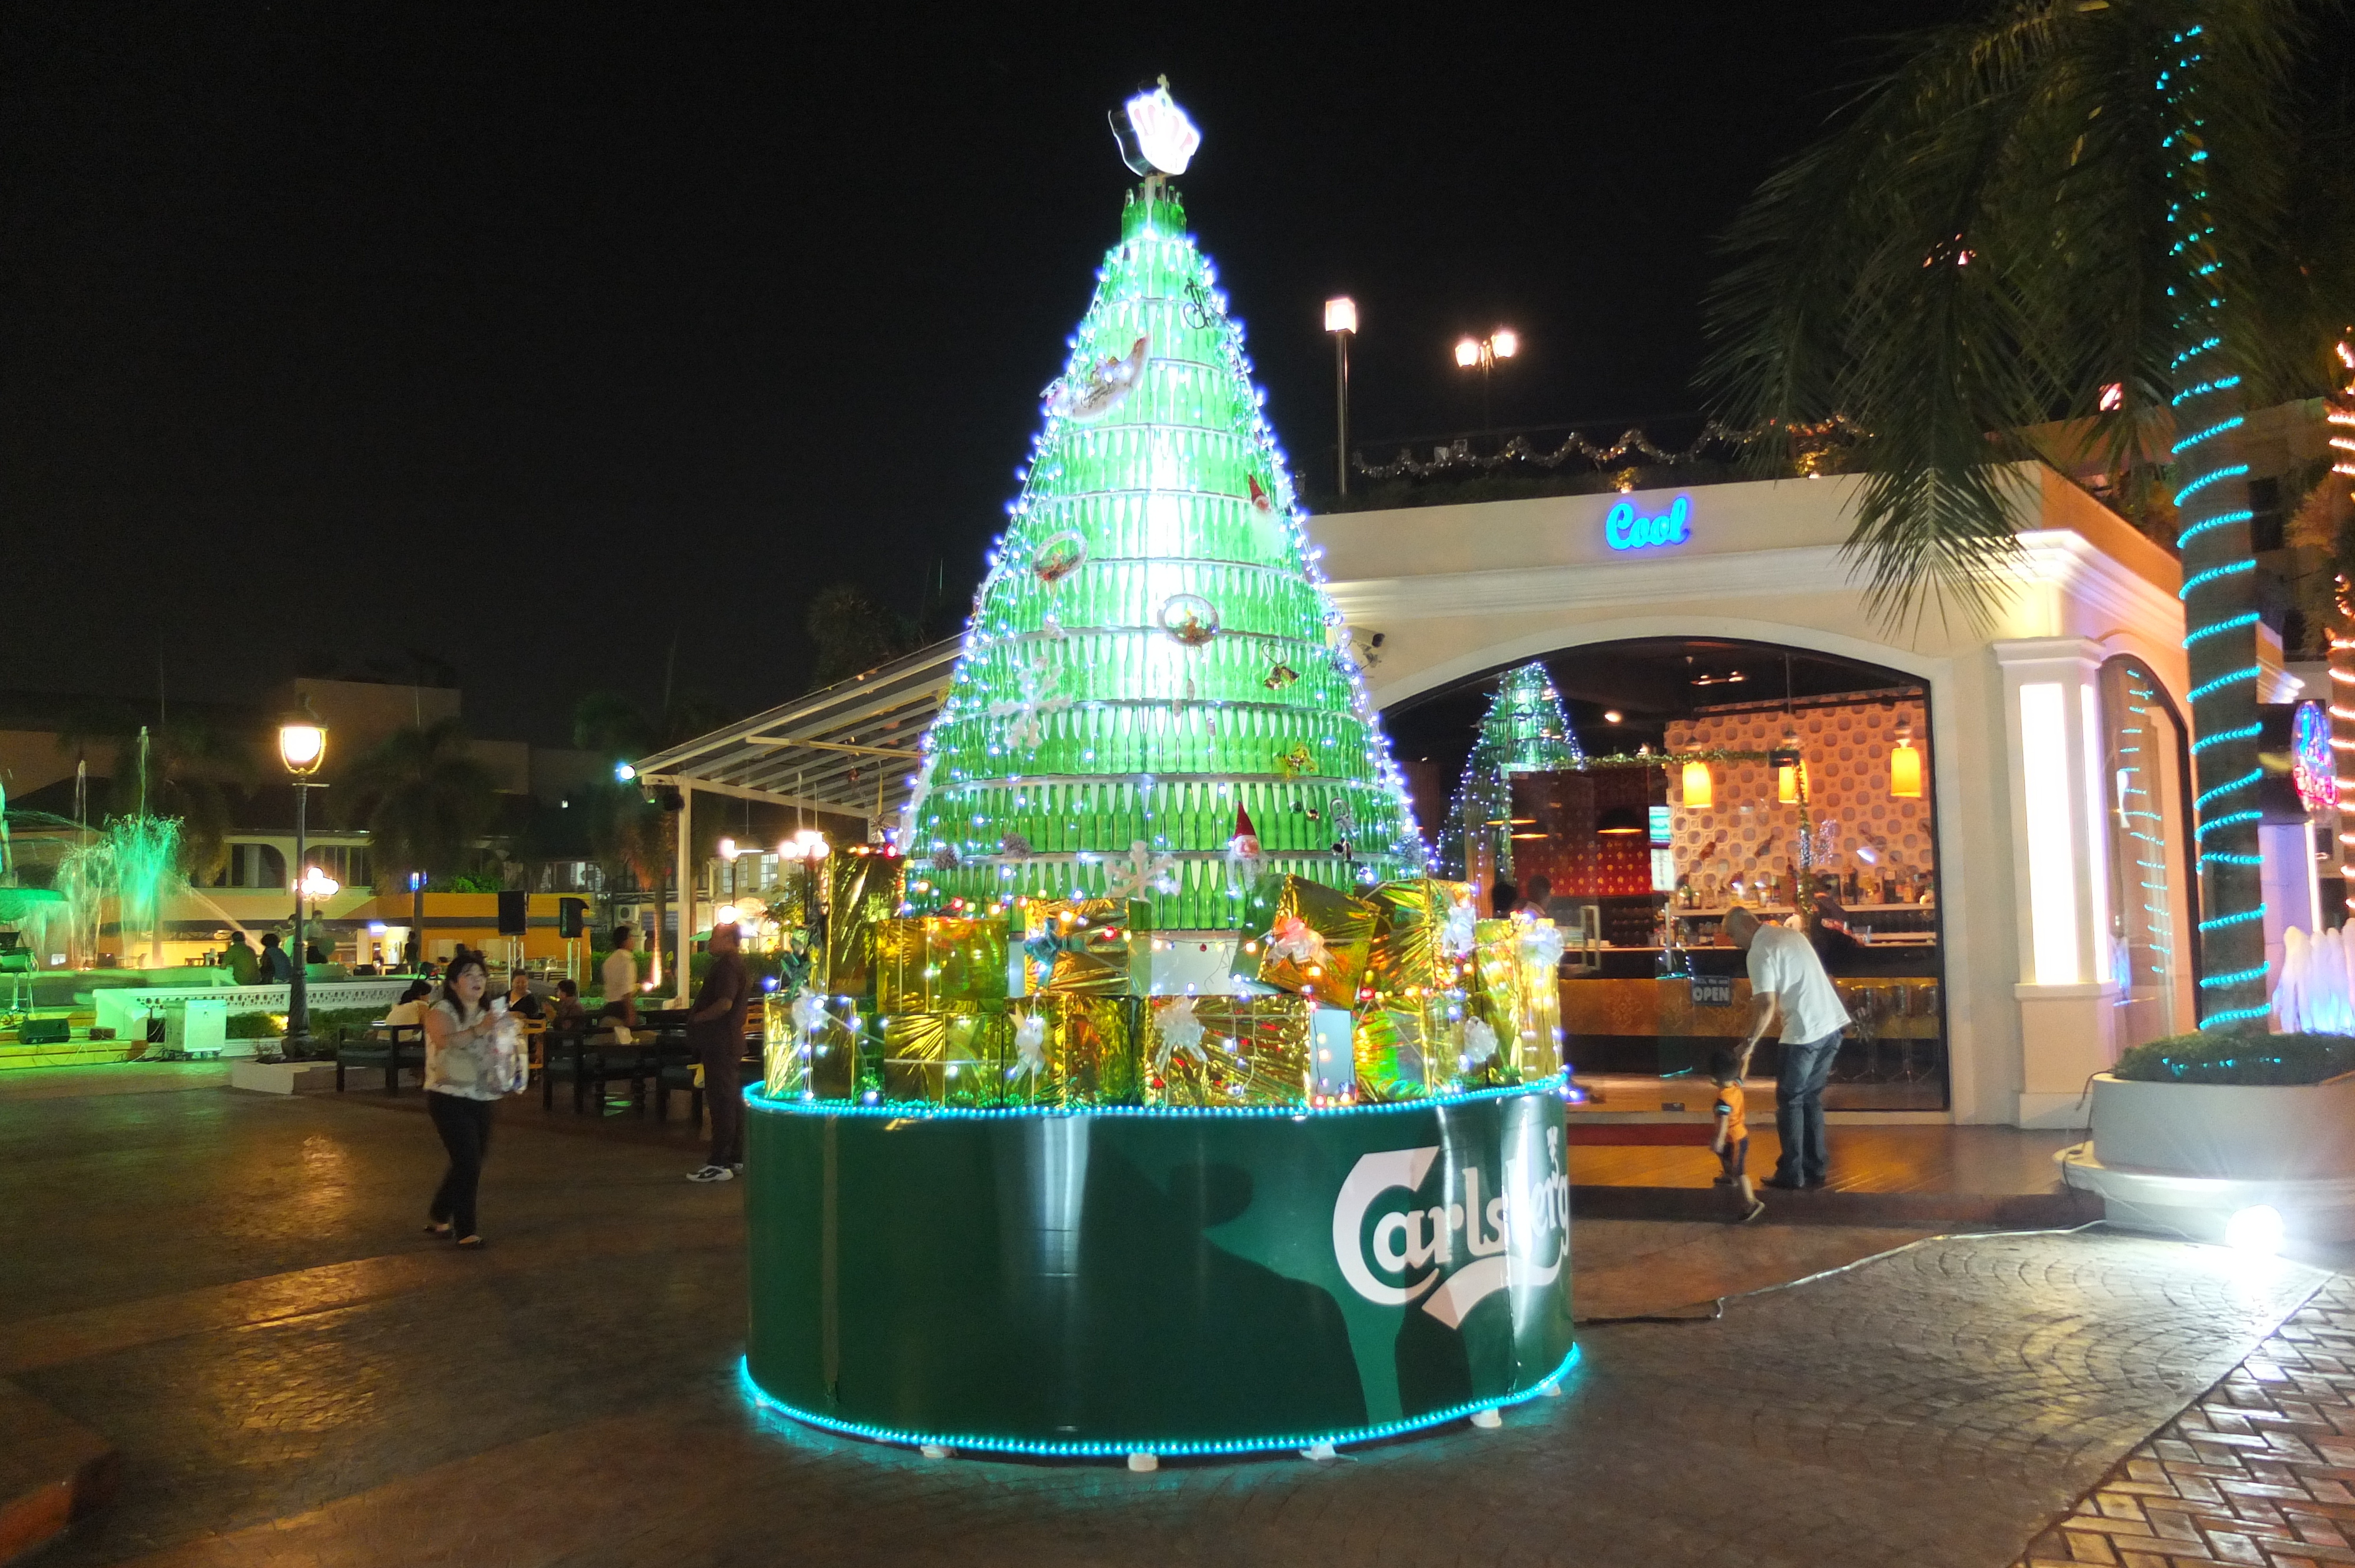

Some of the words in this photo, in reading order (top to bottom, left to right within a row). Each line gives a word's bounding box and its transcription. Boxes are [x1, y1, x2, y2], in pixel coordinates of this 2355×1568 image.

[1606, 497, 1690, 549] Cool
[1693, 986, 1729, 1001] OPEN
[1333, 1143, 1570, 1305] Carlsberg
